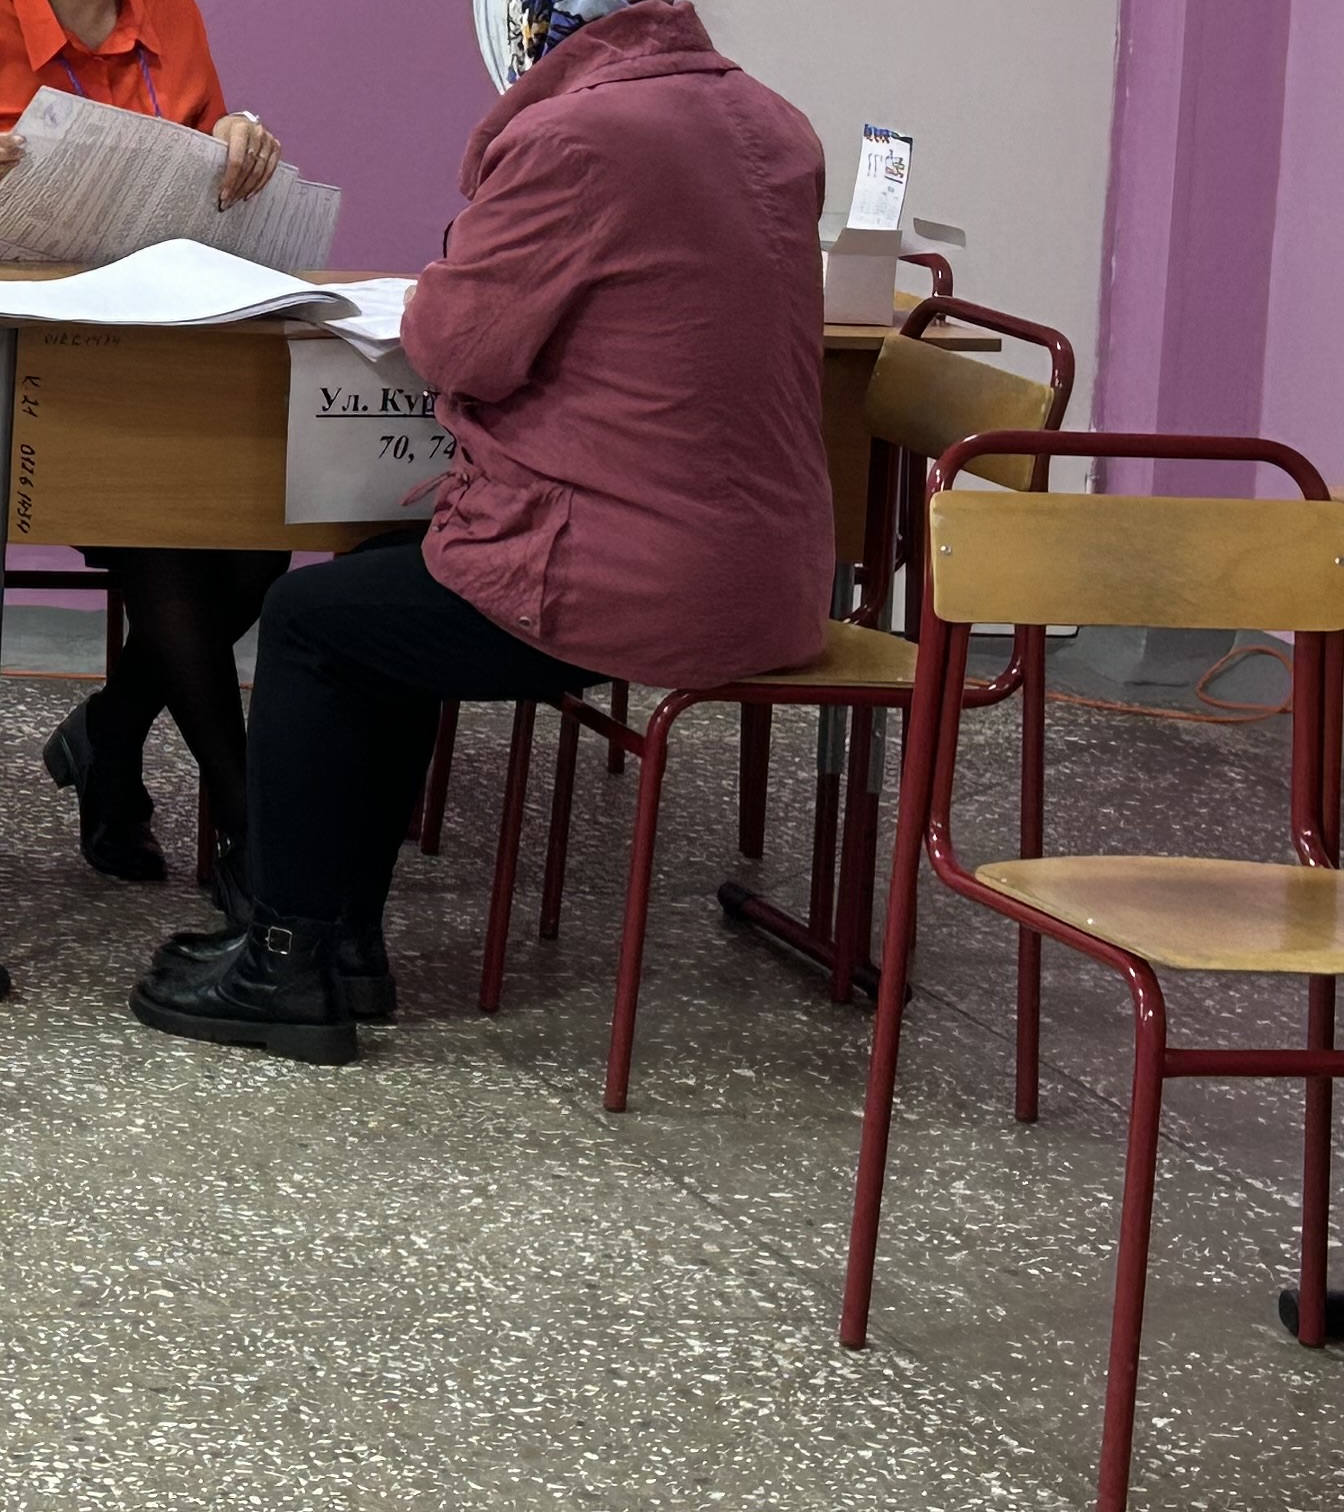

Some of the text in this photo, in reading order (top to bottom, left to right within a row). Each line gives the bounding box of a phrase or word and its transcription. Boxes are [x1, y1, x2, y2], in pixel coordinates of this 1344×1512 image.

[319, 387, 436, 416] Ул. Кур
[378, 435, 415, 464] 70,
